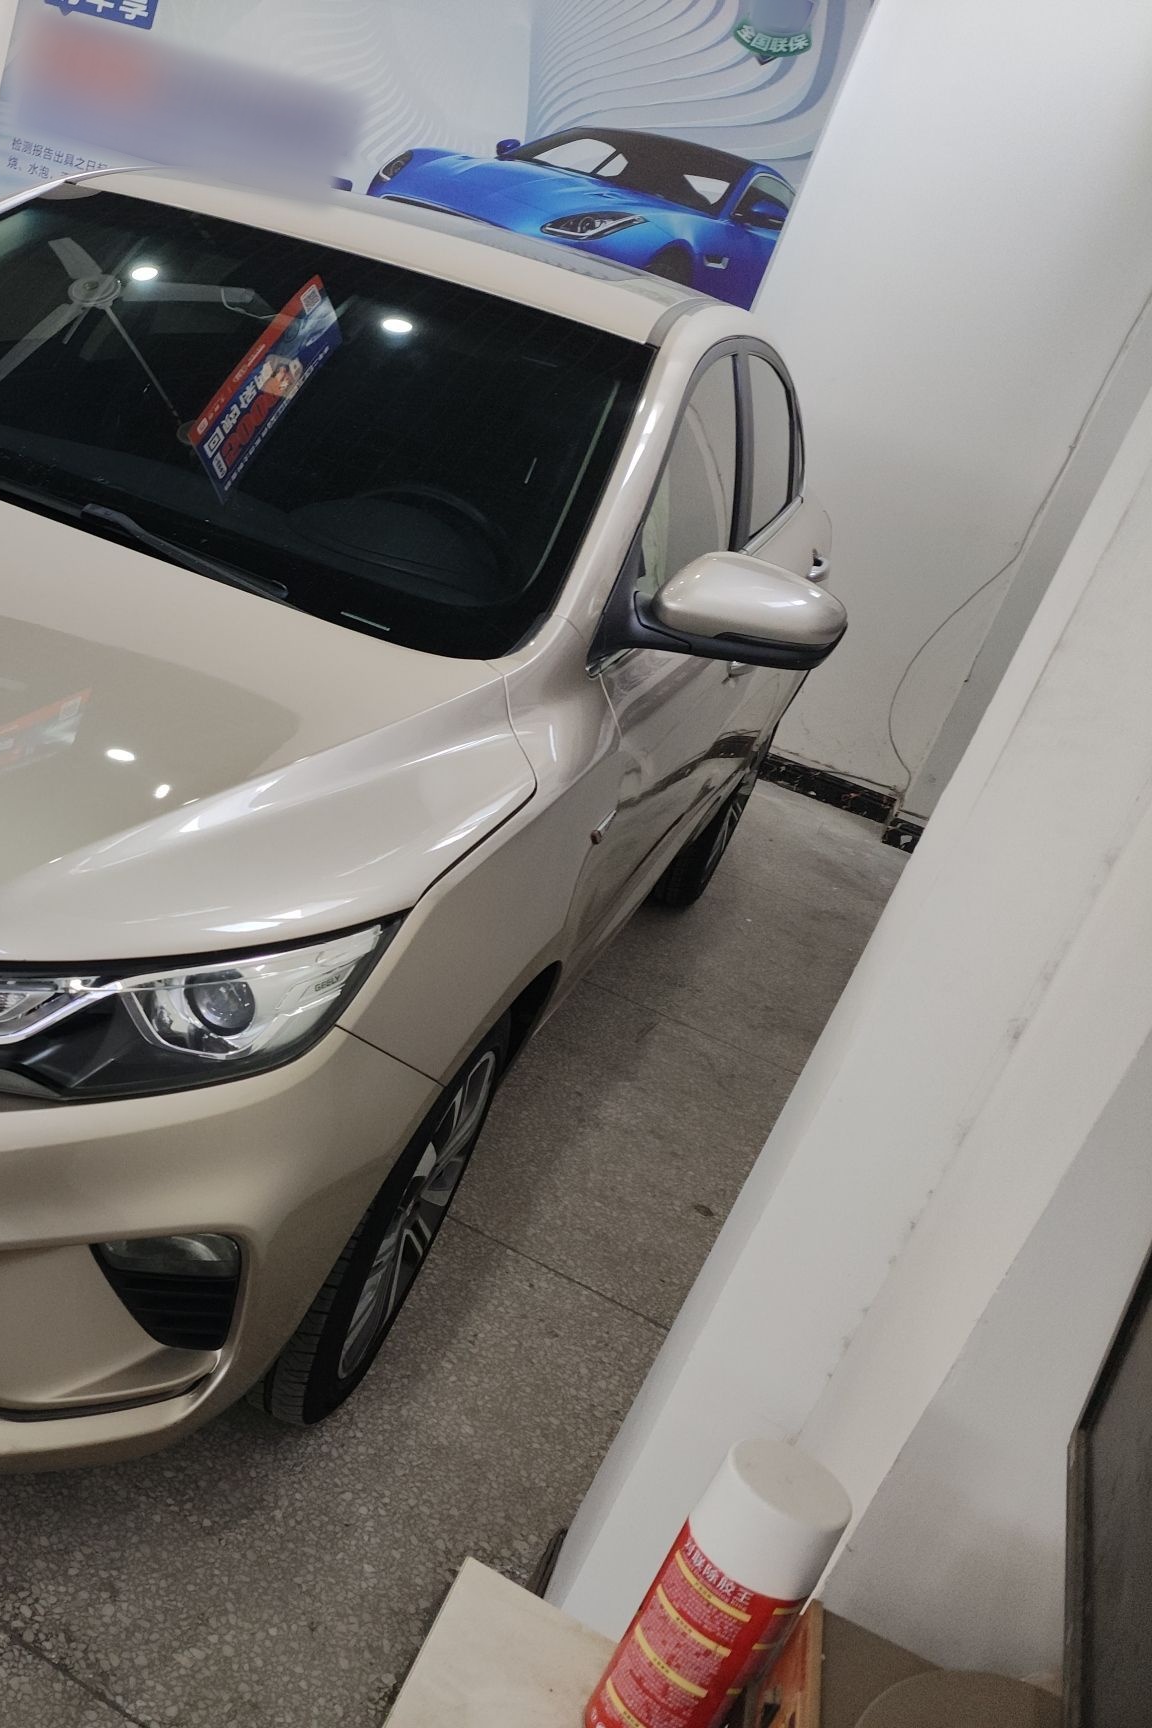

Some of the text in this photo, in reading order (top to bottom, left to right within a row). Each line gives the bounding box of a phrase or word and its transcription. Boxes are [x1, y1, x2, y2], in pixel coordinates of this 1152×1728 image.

[737, 25, 808, 52] 全国联保
[314, 974, 339, 991] GEELY
